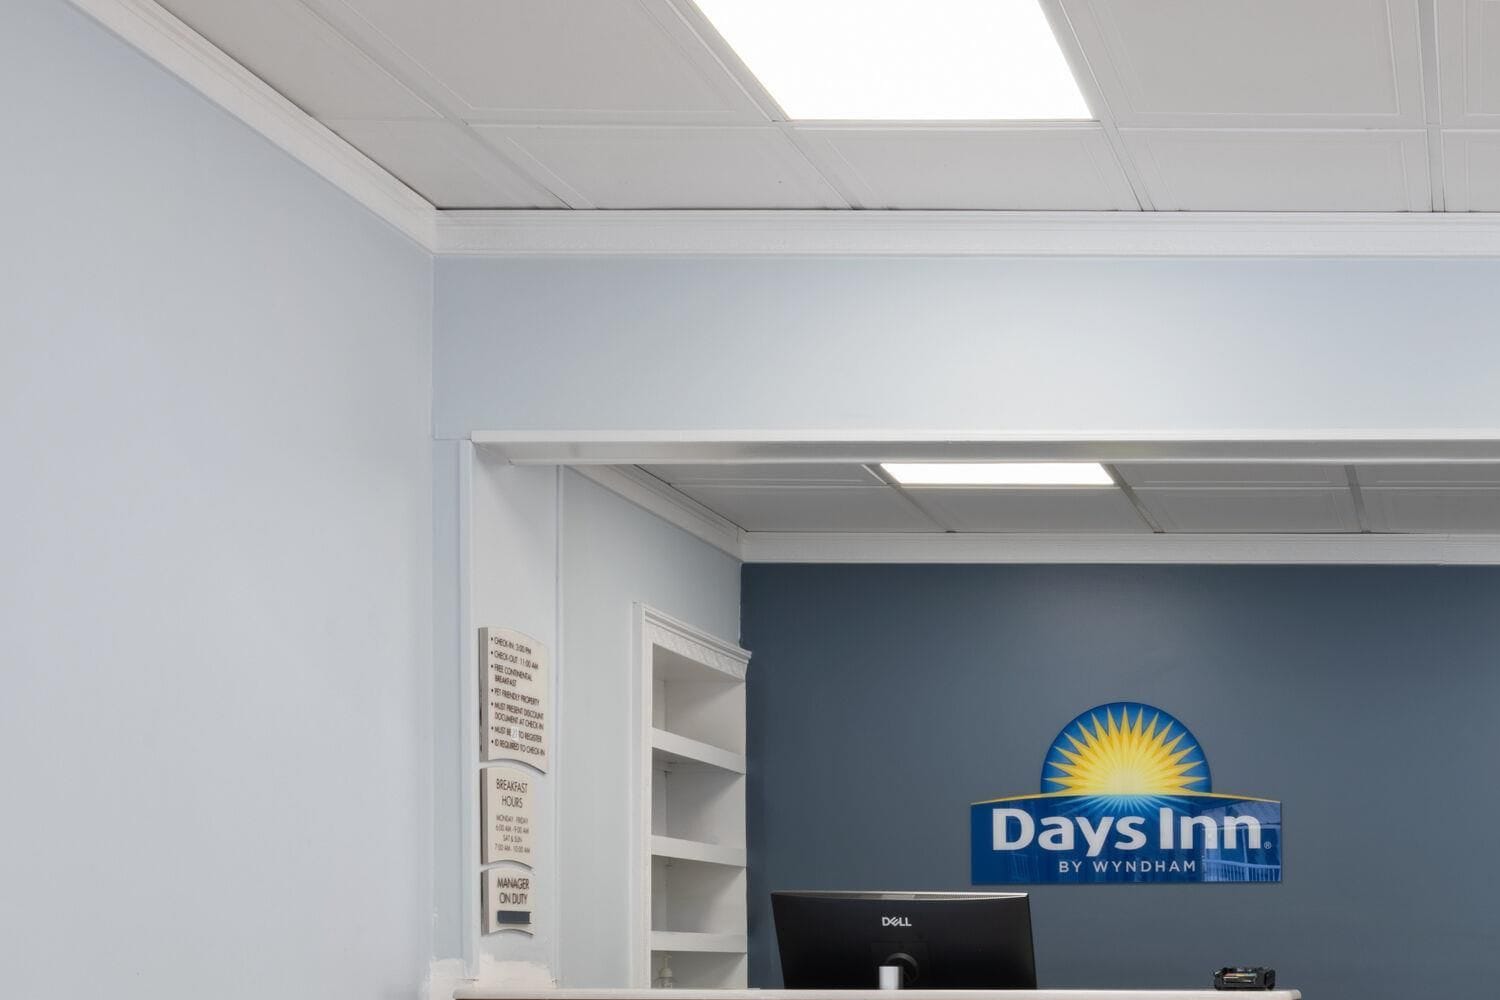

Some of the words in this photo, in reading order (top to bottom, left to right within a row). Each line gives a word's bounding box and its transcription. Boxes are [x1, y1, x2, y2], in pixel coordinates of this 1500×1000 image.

[496, 778, 528, 793] BREAKFAST
[501, 795, 523, 808] HOURS
[992, 808, 1147, 857] Days
[1160, 807, 1262, 850] Inn
[1059, 860, 1083, 873] BY
[1093, 860, 1197, 873] WYNDHAM
[497, 877, 530, 890] MANAGER
[499, 891, 511, 904] ON
[512, 892, 528, 905] DUTY
[882, 917, 912, 927] DELL
